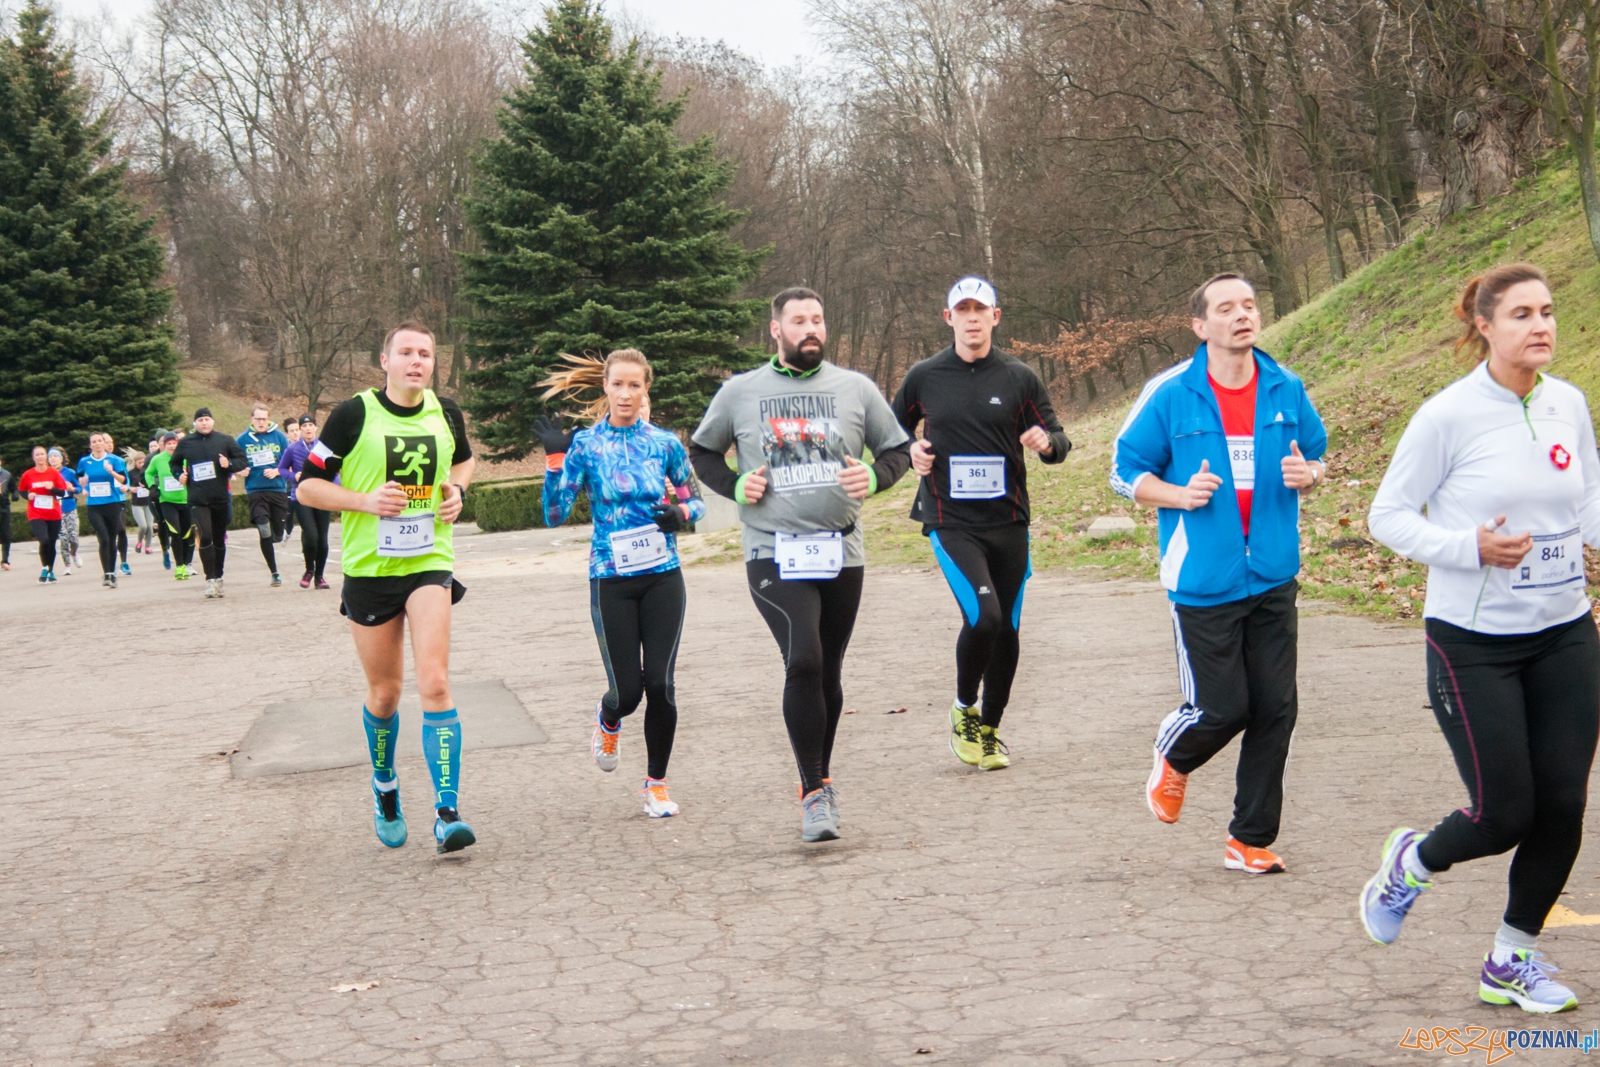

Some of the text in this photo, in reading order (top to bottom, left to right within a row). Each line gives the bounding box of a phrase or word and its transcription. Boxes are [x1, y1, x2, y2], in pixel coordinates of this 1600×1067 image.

[760, 396, 838, 422] POWSTANIE
[969, 468, 987, 477] 361
[408, 499, 431, 508] ners
[399, 524, 419, 534] 220
[631, 538, 650, 550] 941
[805, 545, 819, 555] 55
[1541, 545, 1565, 561] 841
